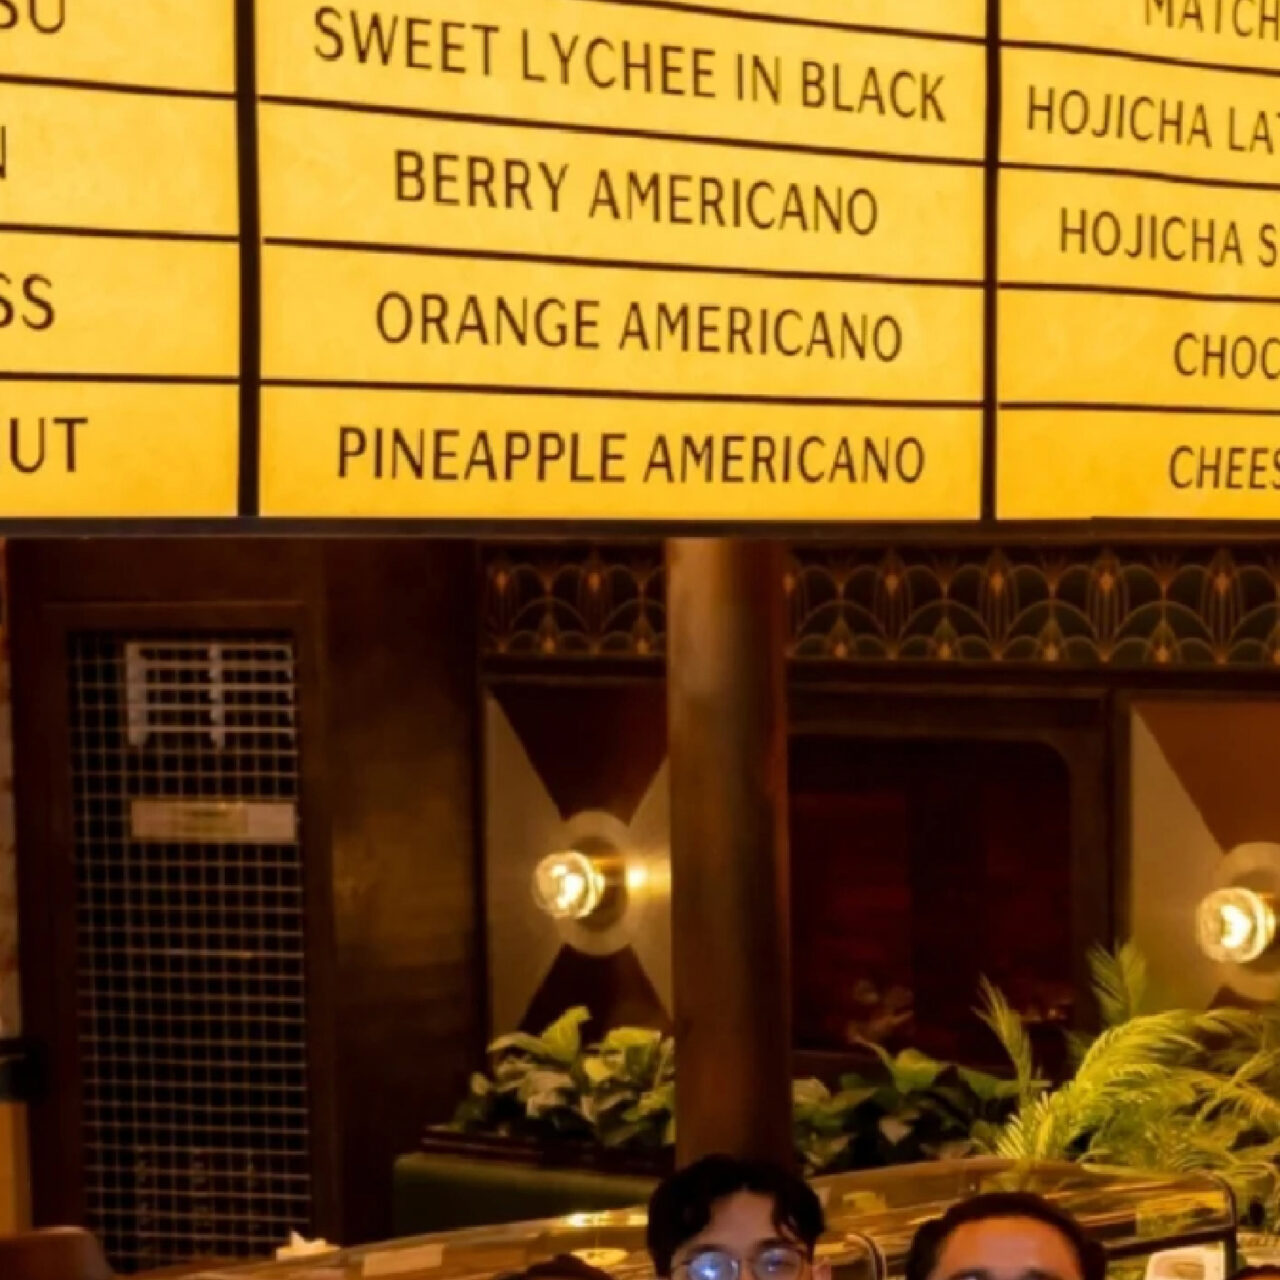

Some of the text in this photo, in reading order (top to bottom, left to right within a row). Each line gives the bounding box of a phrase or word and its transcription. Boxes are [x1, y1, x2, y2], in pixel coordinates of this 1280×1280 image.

[314, 5, 946, 123] SWEET LYCHEE IN BLACK
[1026, 84, 1213, 149] HOJICHA
[394, 148, 879, 237] BERRY AMERICANO
[1060, 207, 1244, 266] HOJICHA
[375, 290, 904, 363] ORANGE AMERICANO
[337, 425, 926, 485] PINEAPPLE AMERICANO
